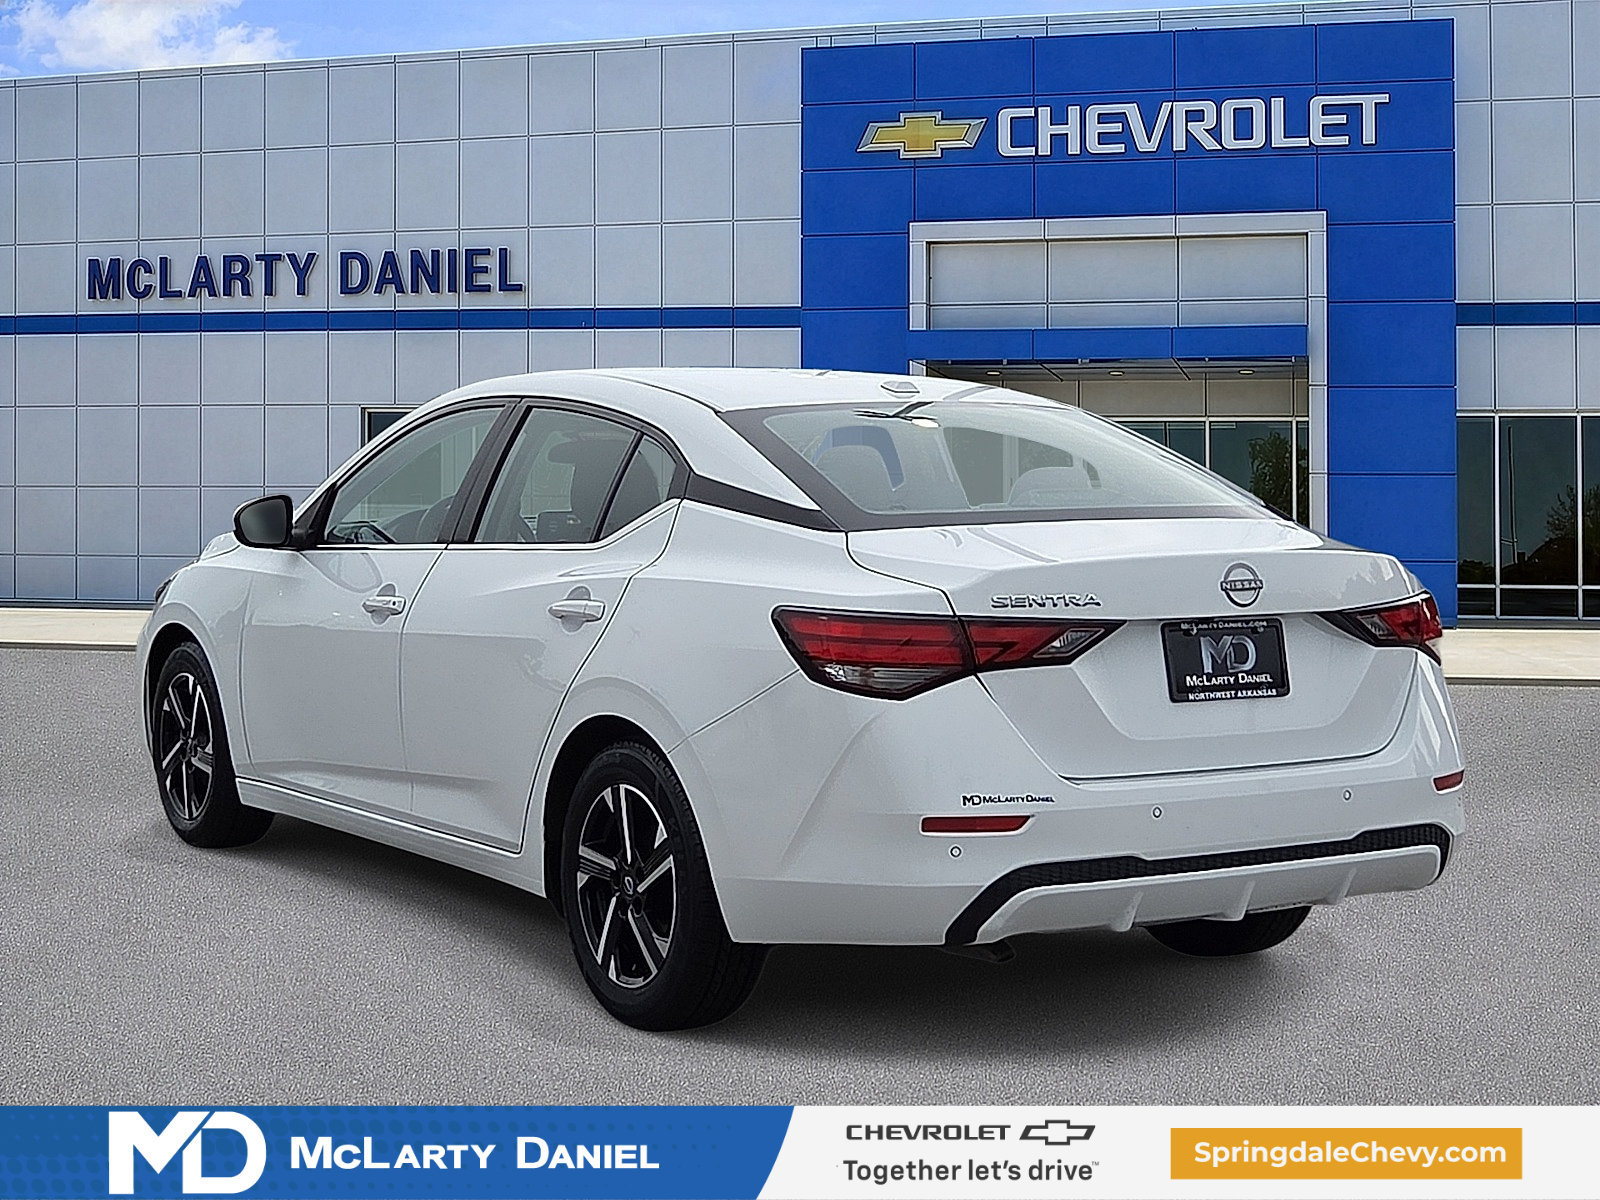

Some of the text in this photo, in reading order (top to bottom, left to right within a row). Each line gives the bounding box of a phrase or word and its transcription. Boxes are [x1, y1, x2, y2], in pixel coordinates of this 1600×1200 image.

[997, 94, 1390, 157] CHEVROLET
[340, 246, 525, 295] DANIEL
[991, 593, 1102, 608] SENTRA
